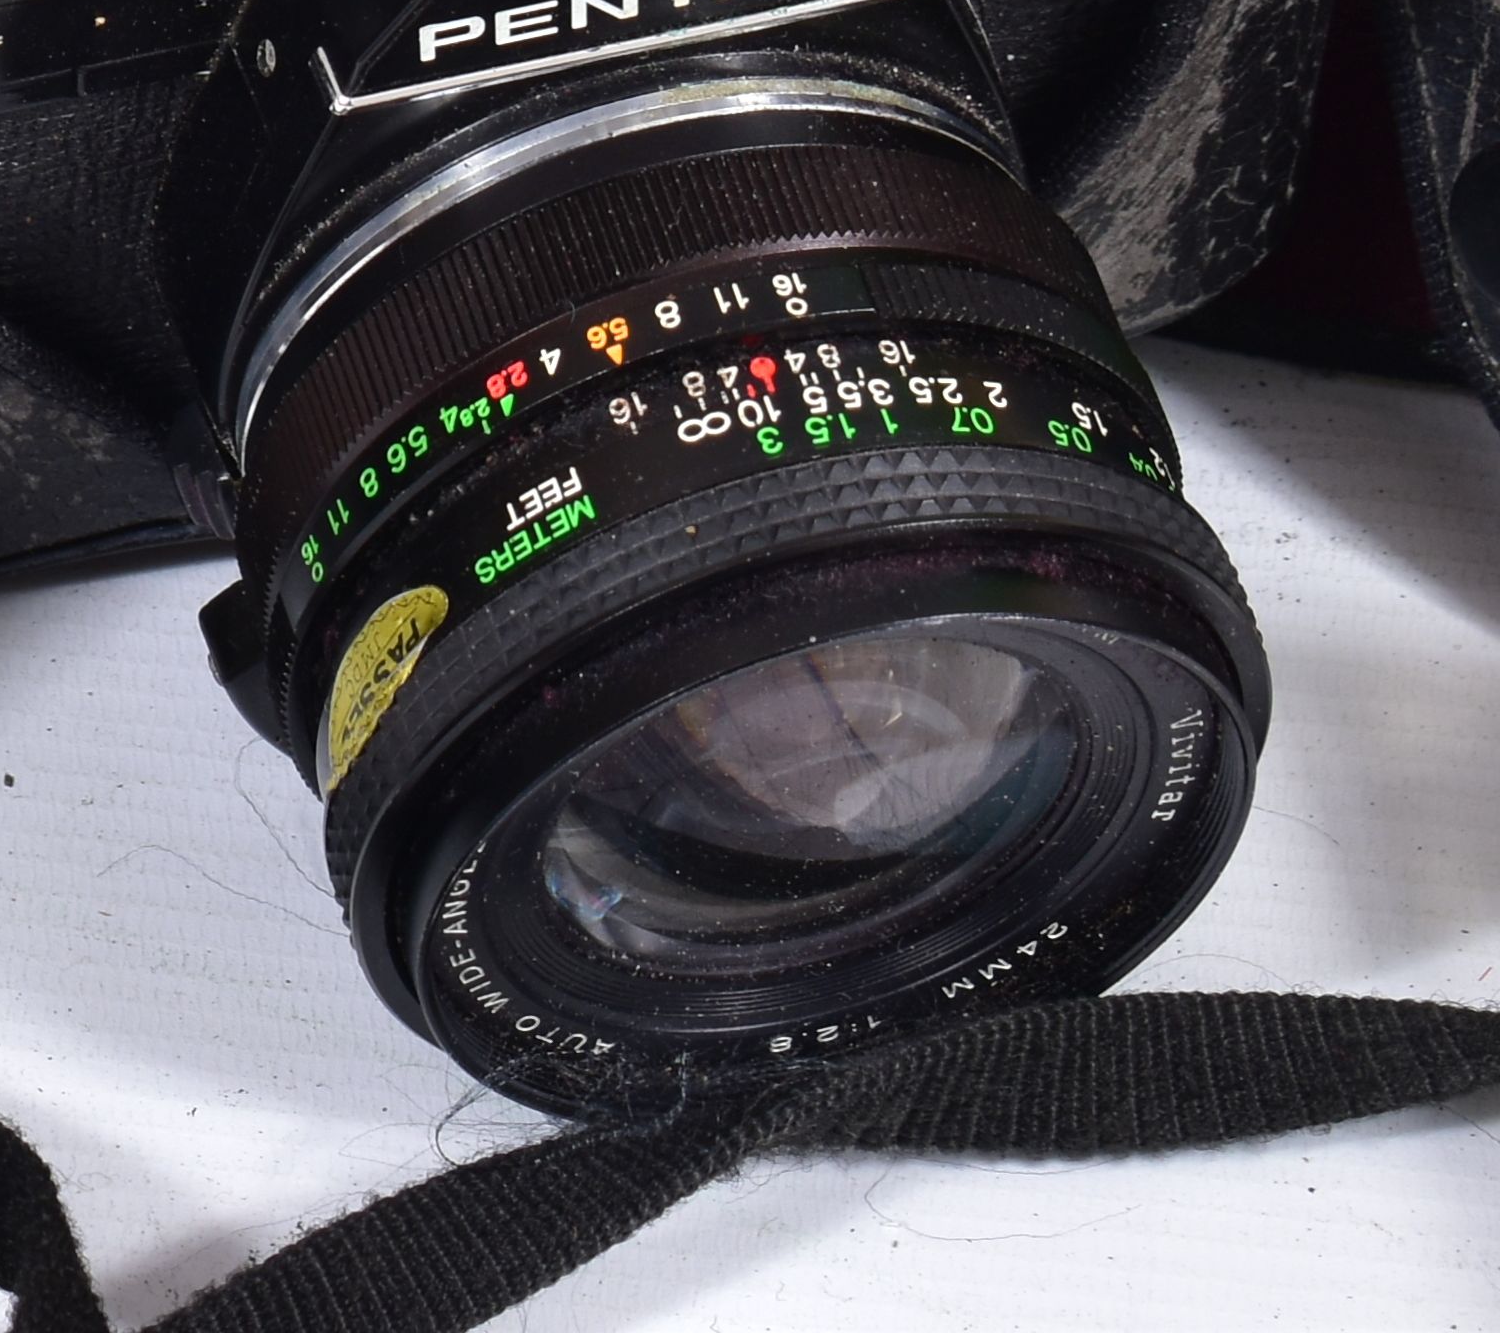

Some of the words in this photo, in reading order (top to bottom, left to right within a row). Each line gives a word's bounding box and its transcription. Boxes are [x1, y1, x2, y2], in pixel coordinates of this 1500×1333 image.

[713, 282, 750, 314] 11
[771, 272, 807, 296] 16
[654, 299, 682, 330] 8
[586, 317, 629, 350] 5.6
[538, 347, 561, 376] 4
[784, 348, 806, 373] 4
[816, 343, 841, 369] 8
[878, 338, 916, 366] 16
[486, 360, 529, 399] 2.8
[681, 371, 707, 398] 8
[716, 365, 739, 389] 4
[908, 376, 963, 405] 2.5
[608, 391, 648, 425] 16
[802, 385, 829, 414] 5
[836, 377, 894, 410] 3.5
[983, 380, 1008, 409] 2
[737, 394, 782, 429] 10
[880, 407, 899, 435] 1
[952, 406, 995, 435] 0.7
[1071, 401, 1108, 437] 1.5
[756, 426, 784, 455] 3
[804, 412, 856, 445] 1.5
[1047, 419, 1093, 453] 0.5
[386, 425, 429, 473] 5.6
[359, 466, 380, 498] 8
[506, 466, 582, 531] FEET
[326, 498, 350, 536] 11
[301, 534, 320, 566] 16
[474, 494, 596, 584] METERS
[1151, 709, 1204, 822] Vivitar
[941, 921, 1069, 999] 24MM
[515, 1014, 617, 1054] AUTO
[769, 1014, 882, 1053] 1:2.8
